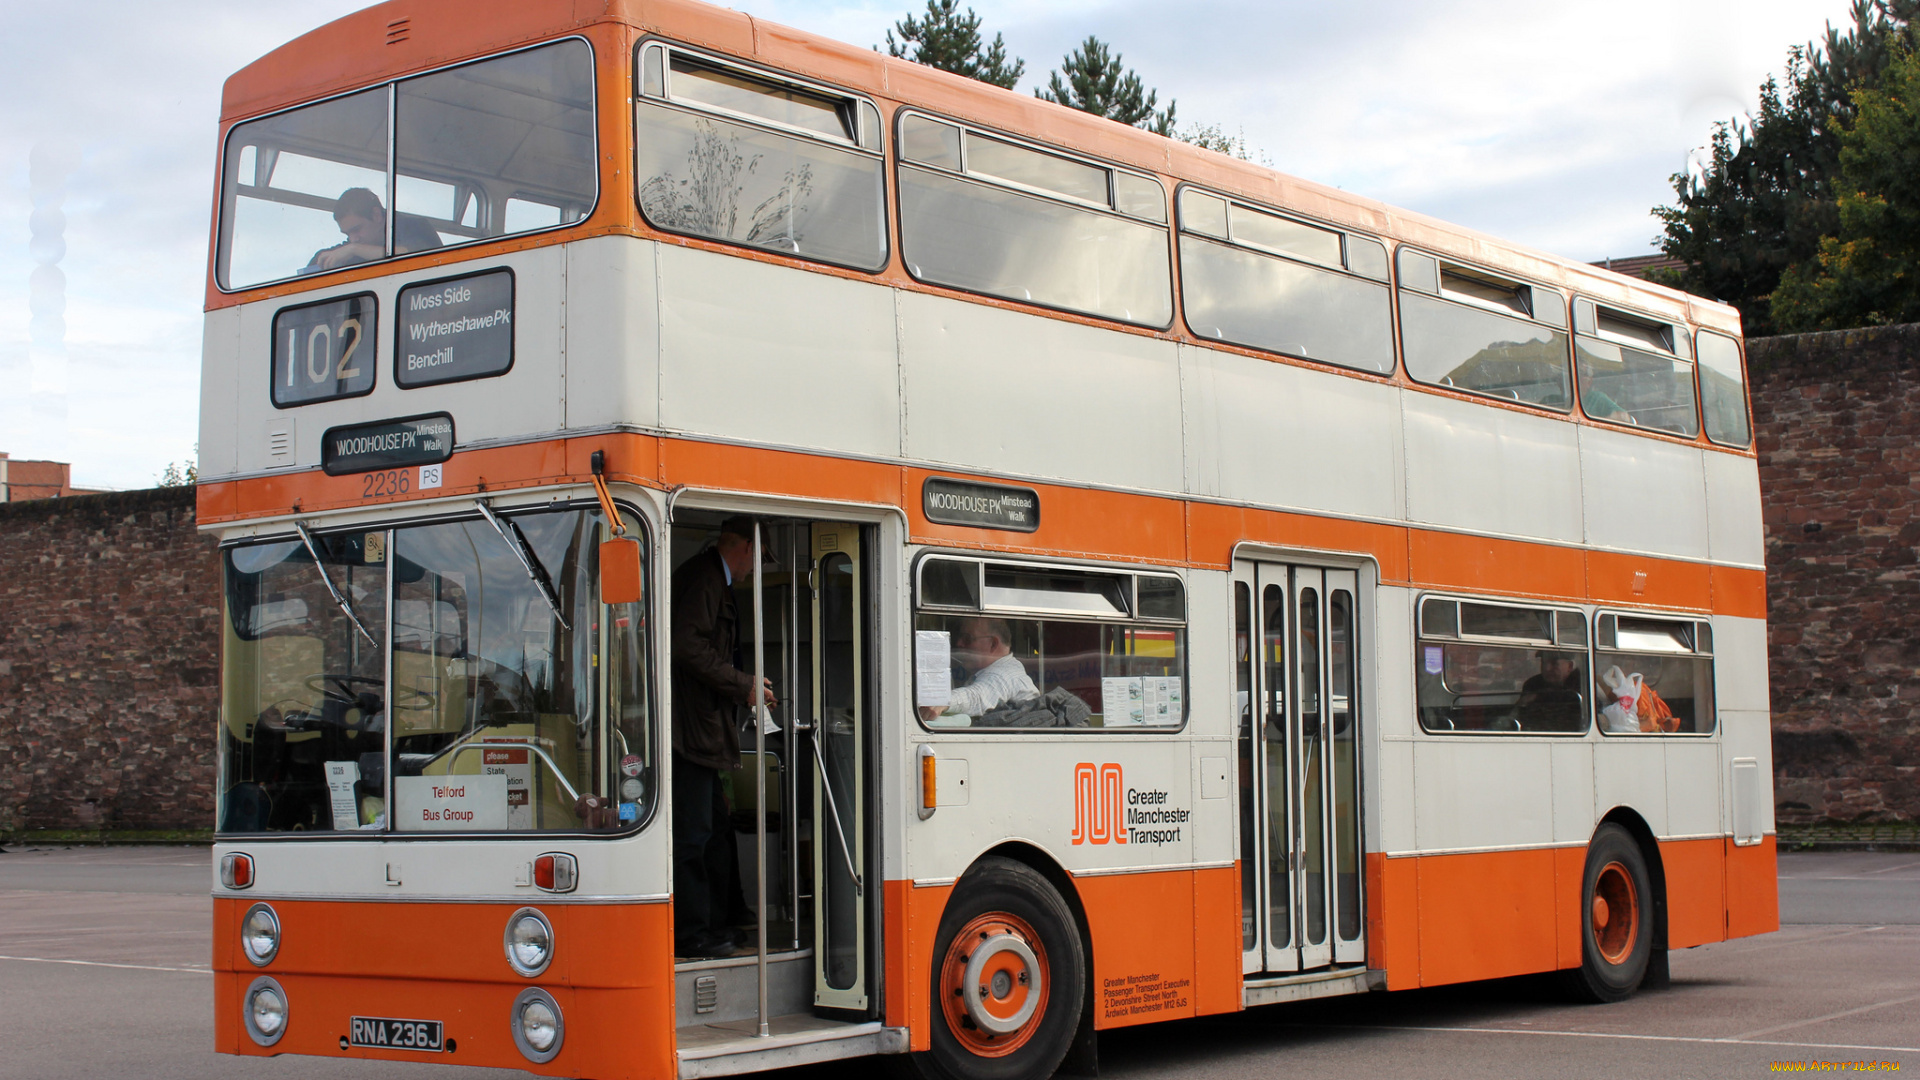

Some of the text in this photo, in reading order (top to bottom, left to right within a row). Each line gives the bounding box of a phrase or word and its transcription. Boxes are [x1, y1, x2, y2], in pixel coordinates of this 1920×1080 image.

[410, 286, 471, 311] Moss Side
[409, 308, 511, 343] Wythenshawe Pk
[287, 319, 361, 387] 102
[407, 346, 454, 370] Benchill
[336, 430, 417, 457] WOODHOUSE PK
[423, 438, 443, 452] Walk
[362, 469, 410, 499] 2236
[422, 468, 439, 485] PS
[929, 492, 1002, 515] WOODHOUSE PK
[1001, 494, 1032, 509] Minstead
[1008, 510, 1026, 522] Walk
[486, 752, 509, 761] please
[487, 766, 506, 776] State
[432, 785, 465, 799] Telford
[1128, 788, 1168, 805] Greater
[423, 807, 474, 823] Bus Group
[1128, 808, 1190, 825] Manchester
[1128, 827, 1181, 848] Transport
[1104, 974, 1159, 987] Greater Manchester
[1104, 979, 1189, 998] Passenger Transport Executive
[1105, 990, 1177, 1008] 2 Devonshire Street North
[1105, 1007, 1128, 1018] Ardwick
[1130, 1003, 1162, 1014] Manchester
[1164, 1001, 1175, 1009] M12
[352, 1020, 440, 1048] RNA 236J
